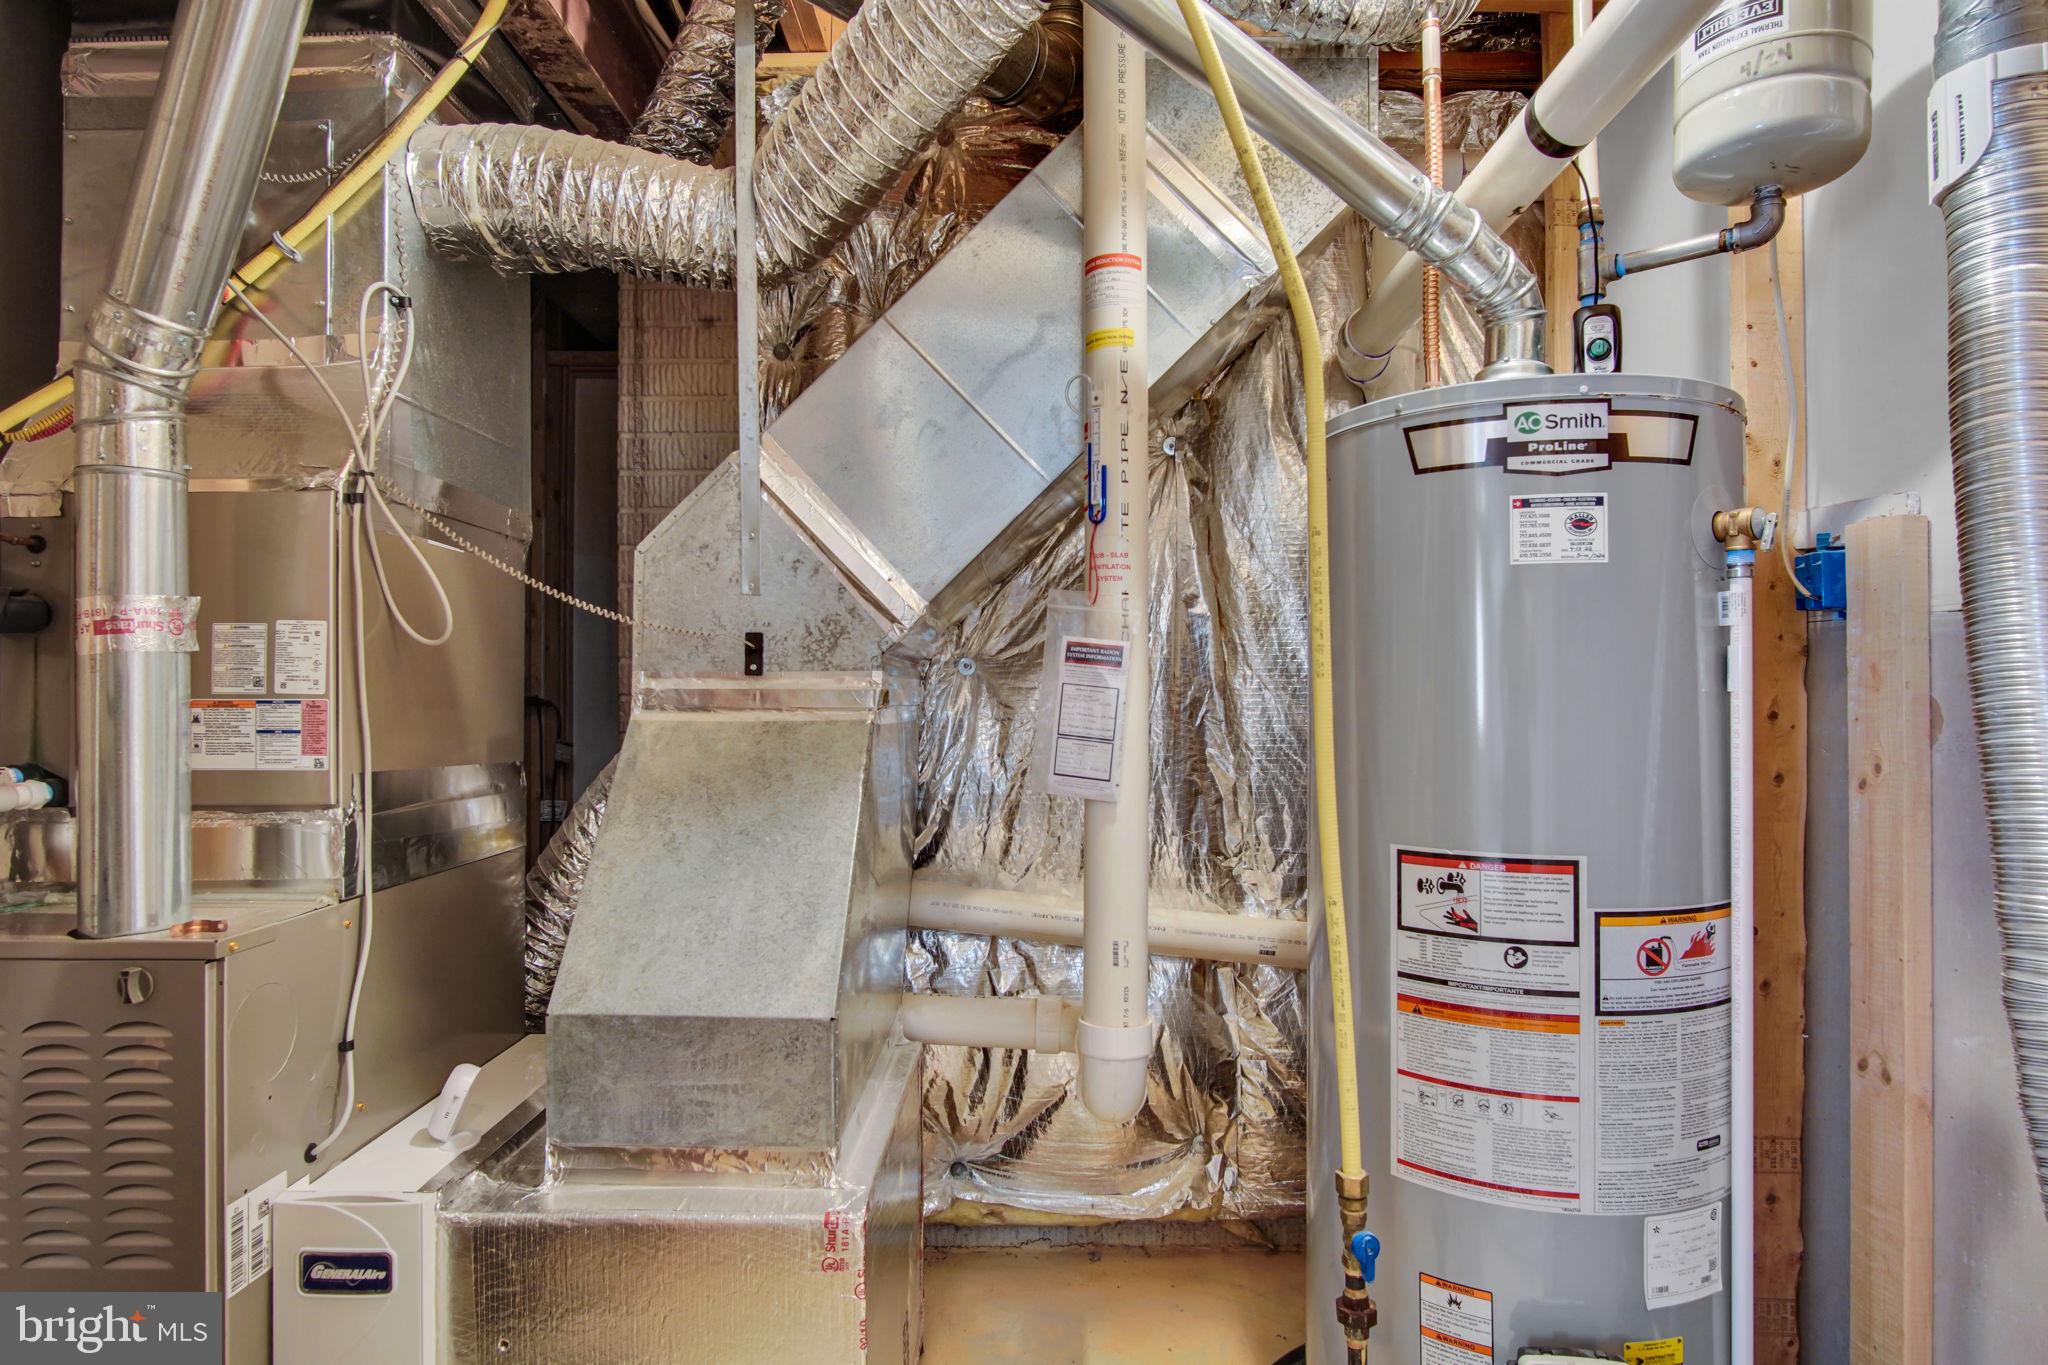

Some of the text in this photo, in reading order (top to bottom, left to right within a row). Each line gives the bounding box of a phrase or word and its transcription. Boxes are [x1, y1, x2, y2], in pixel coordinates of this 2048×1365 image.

[1697, 19, 1784, 59] THERMAL EXPANSION TANK
[1117, 43, 1127, 84] PRESSURE
[1118, 88, 1127, 104] FOR
[1118, 109, 1127, 124] NOT
[1515, 413, 1602, 432] AO Smith
[1120, 421, 1130, 484] PIPE
[1527, 441, 1585, 452] ProLine
[1569, 512, 1594, 522] HALLER
[1070, 646, 1100, 654] IMPORTANT
[1469, 862, 1506, 872] DANGER
[1667, 915, 1697, 924] WARNING
[1447, 980, 1525, 996] IMPORTANT/IMPORTANTE
[1441, 1282, 1475, 1296] WARNING
[1442, 1336, 1476, 1350] WARNING
